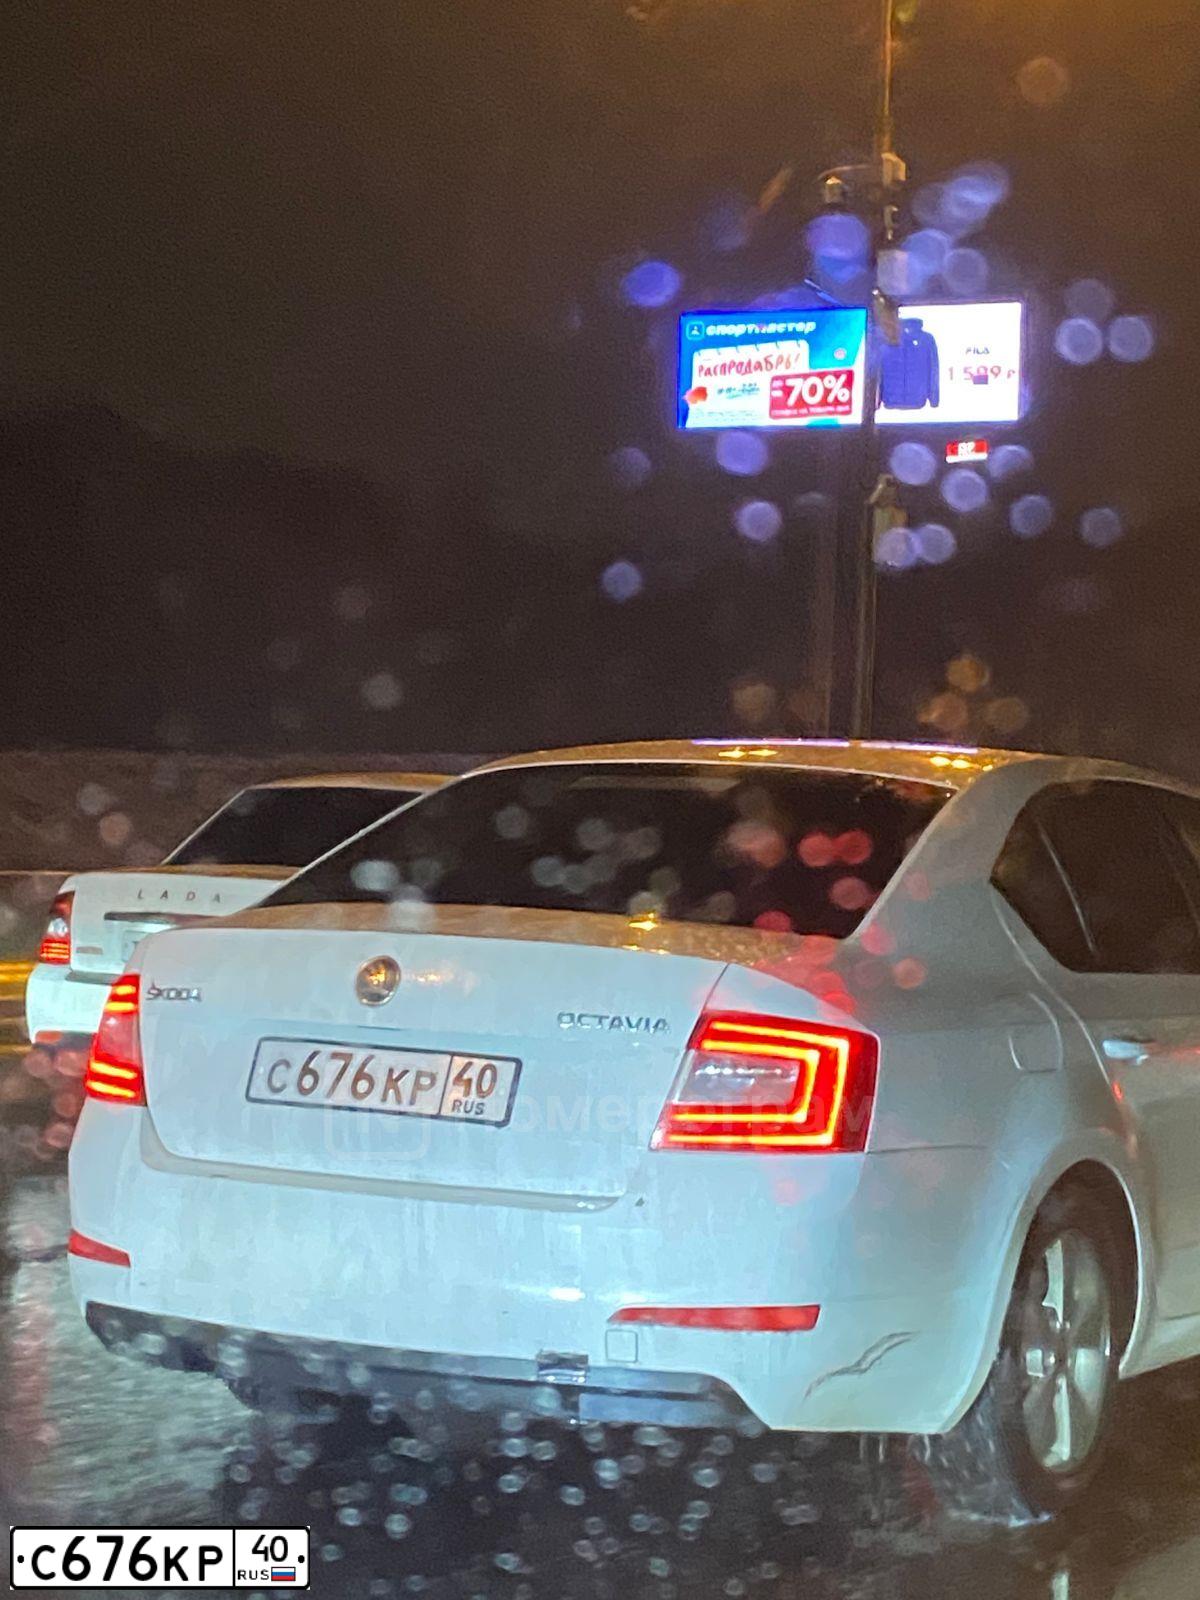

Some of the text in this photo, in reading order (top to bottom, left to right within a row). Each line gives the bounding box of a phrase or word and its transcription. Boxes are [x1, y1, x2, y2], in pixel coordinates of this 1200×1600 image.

[137, 888, 222, 904] LADA
[557, 1011, 671, 1034] OCTAVIA
[453, 1060, 498, 1098] 40
[451, 1099, 486, 1116] RUS
